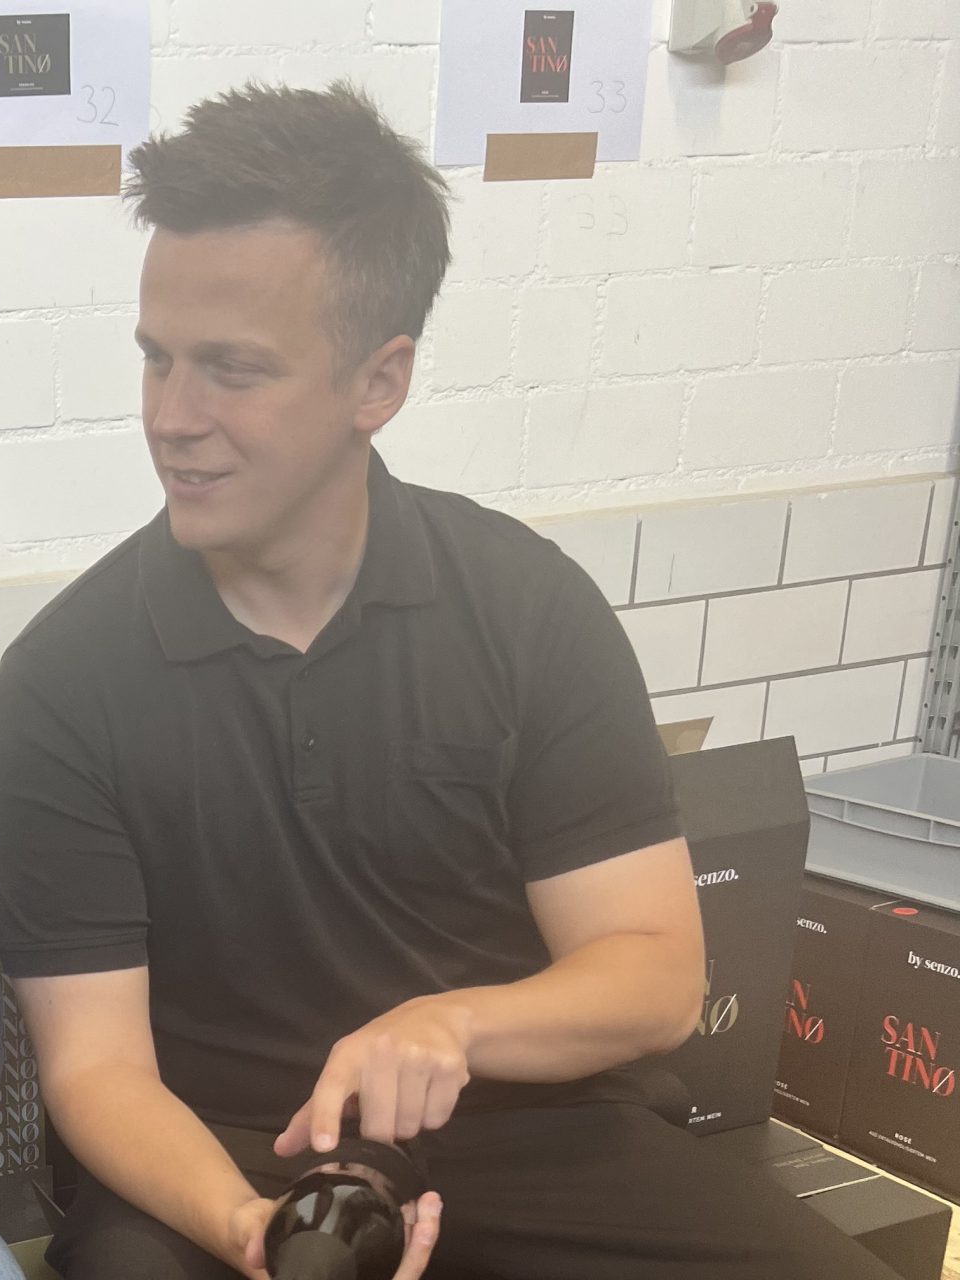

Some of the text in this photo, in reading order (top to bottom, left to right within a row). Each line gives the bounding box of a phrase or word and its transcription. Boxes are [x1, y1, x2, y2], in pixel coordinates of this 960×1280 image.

[76, 84, 119, 126] 32
[587, 80, 627, 114] 33
[907, 951, 960, 979] by senzo.
[881, 1015, 940, 1060] SAN
